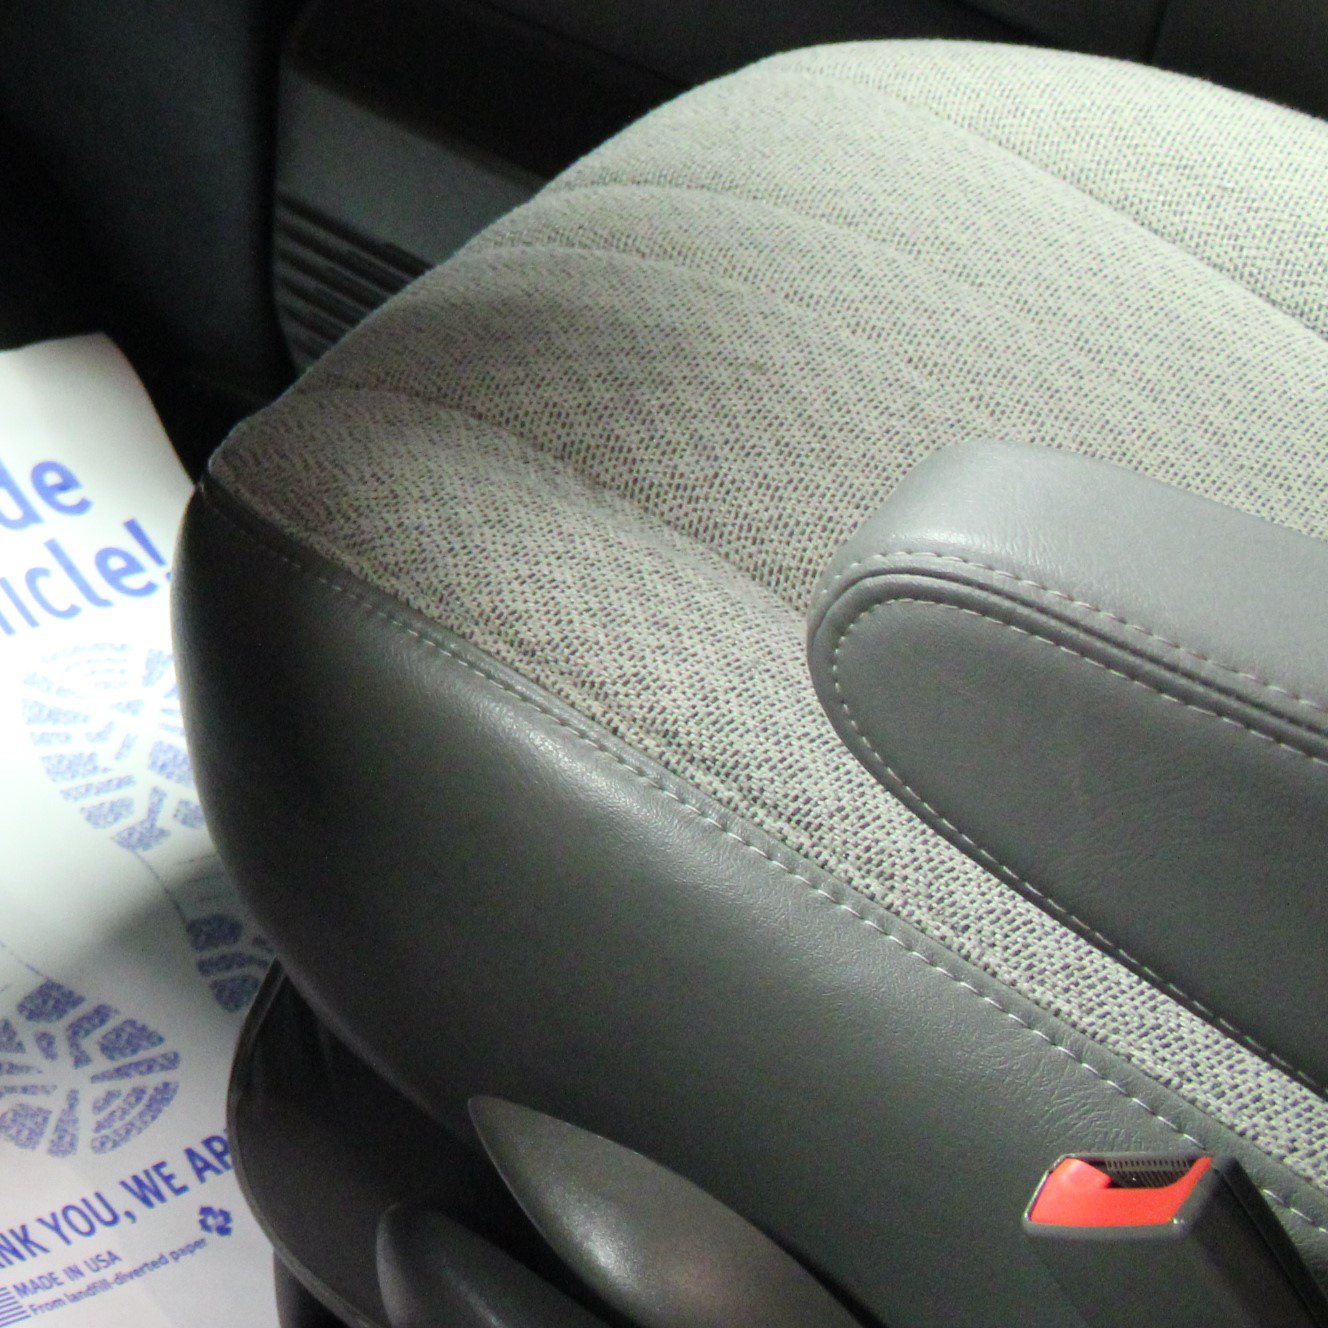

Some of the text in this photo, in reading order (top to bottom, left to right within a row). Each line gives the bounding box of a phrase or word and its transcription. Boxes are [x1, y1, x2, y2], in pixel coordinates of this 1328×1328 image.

[37, 1192, 137, 1246] YOU,
[119, 1161, 189, 1209] WE
[184, 1127, 233, 1184] AP
[13, 1250, 123, 1298] MADE IN USA
[29, 1298, 66, 1315] From
[169, 1238, 207, 1263] paper
